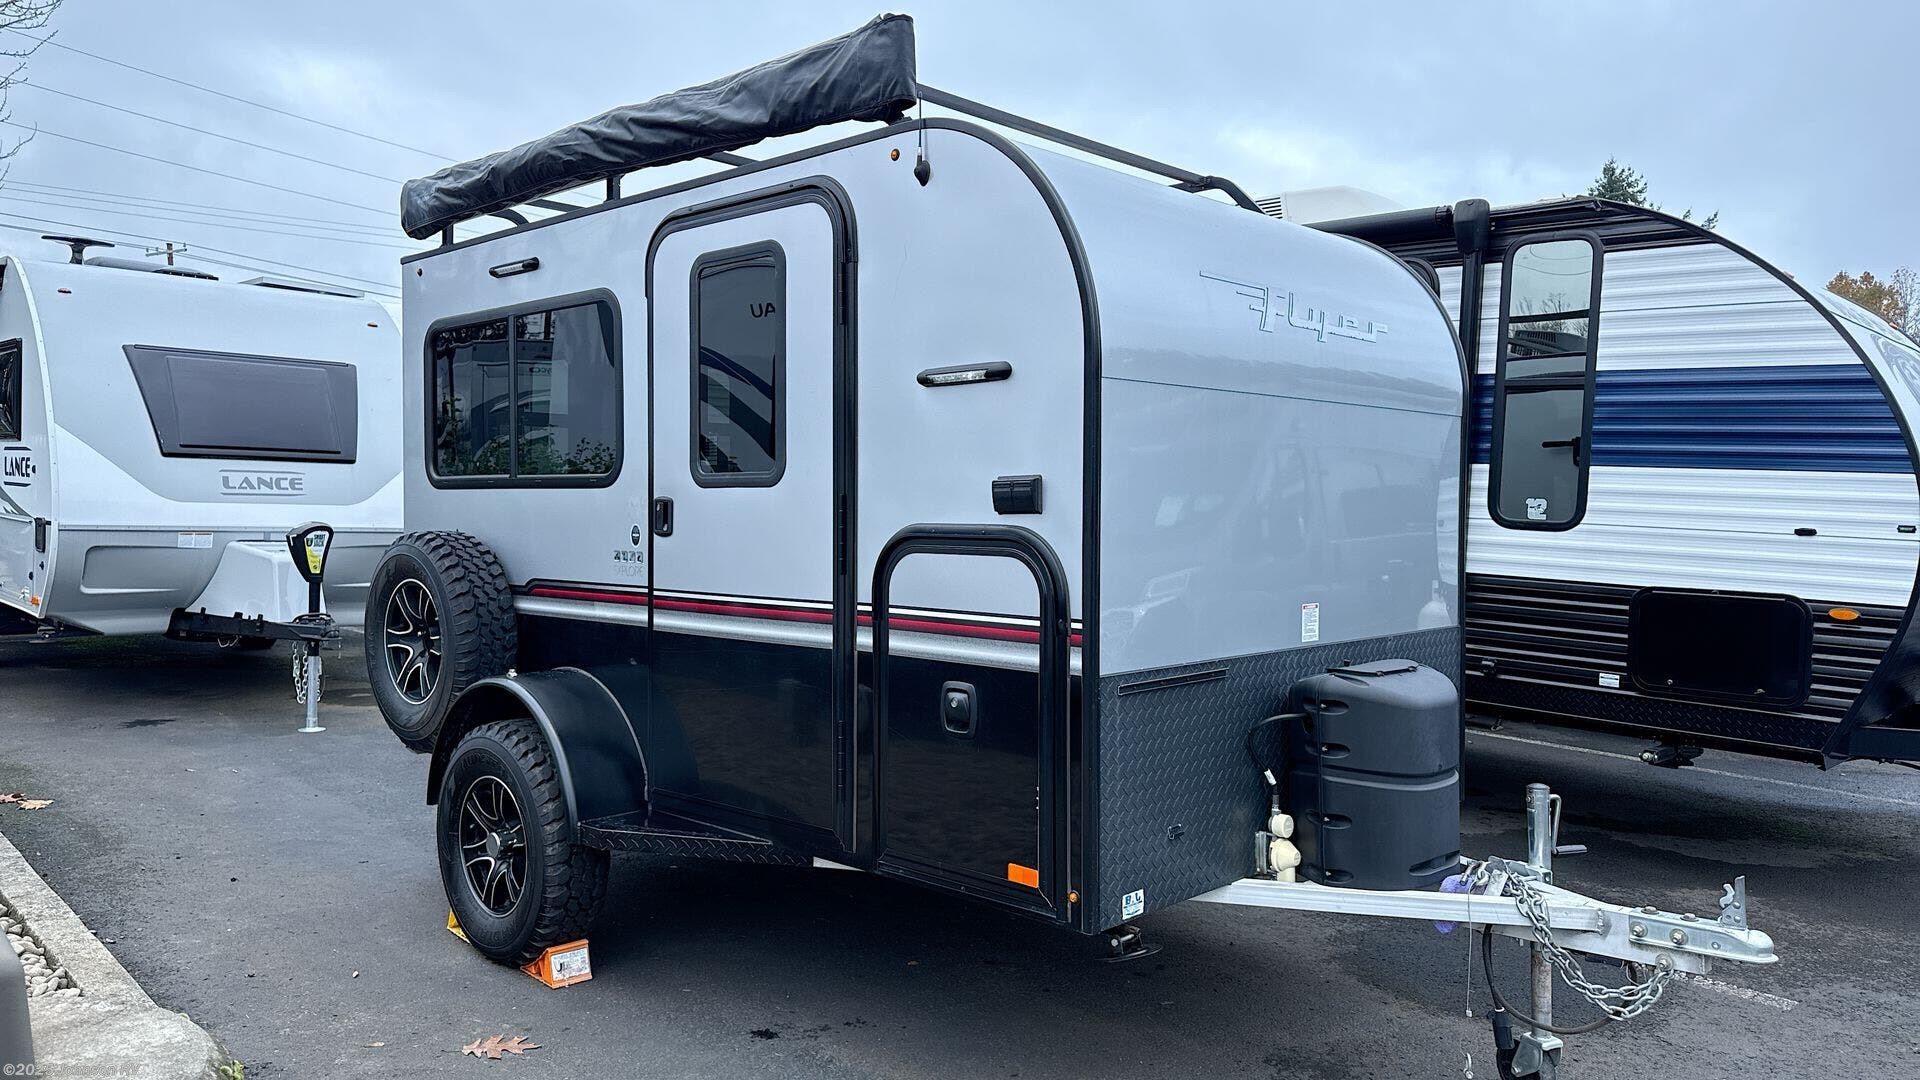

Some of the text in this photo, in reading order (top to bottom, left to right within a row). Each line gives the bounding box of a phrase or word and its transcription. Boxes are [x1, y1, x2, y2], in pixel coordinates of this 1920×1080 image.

[1200, 271, 1388, 343] Flyer
[5, 456, 30, 477] LANCE
[222, 475, 303, 491] LANCE
